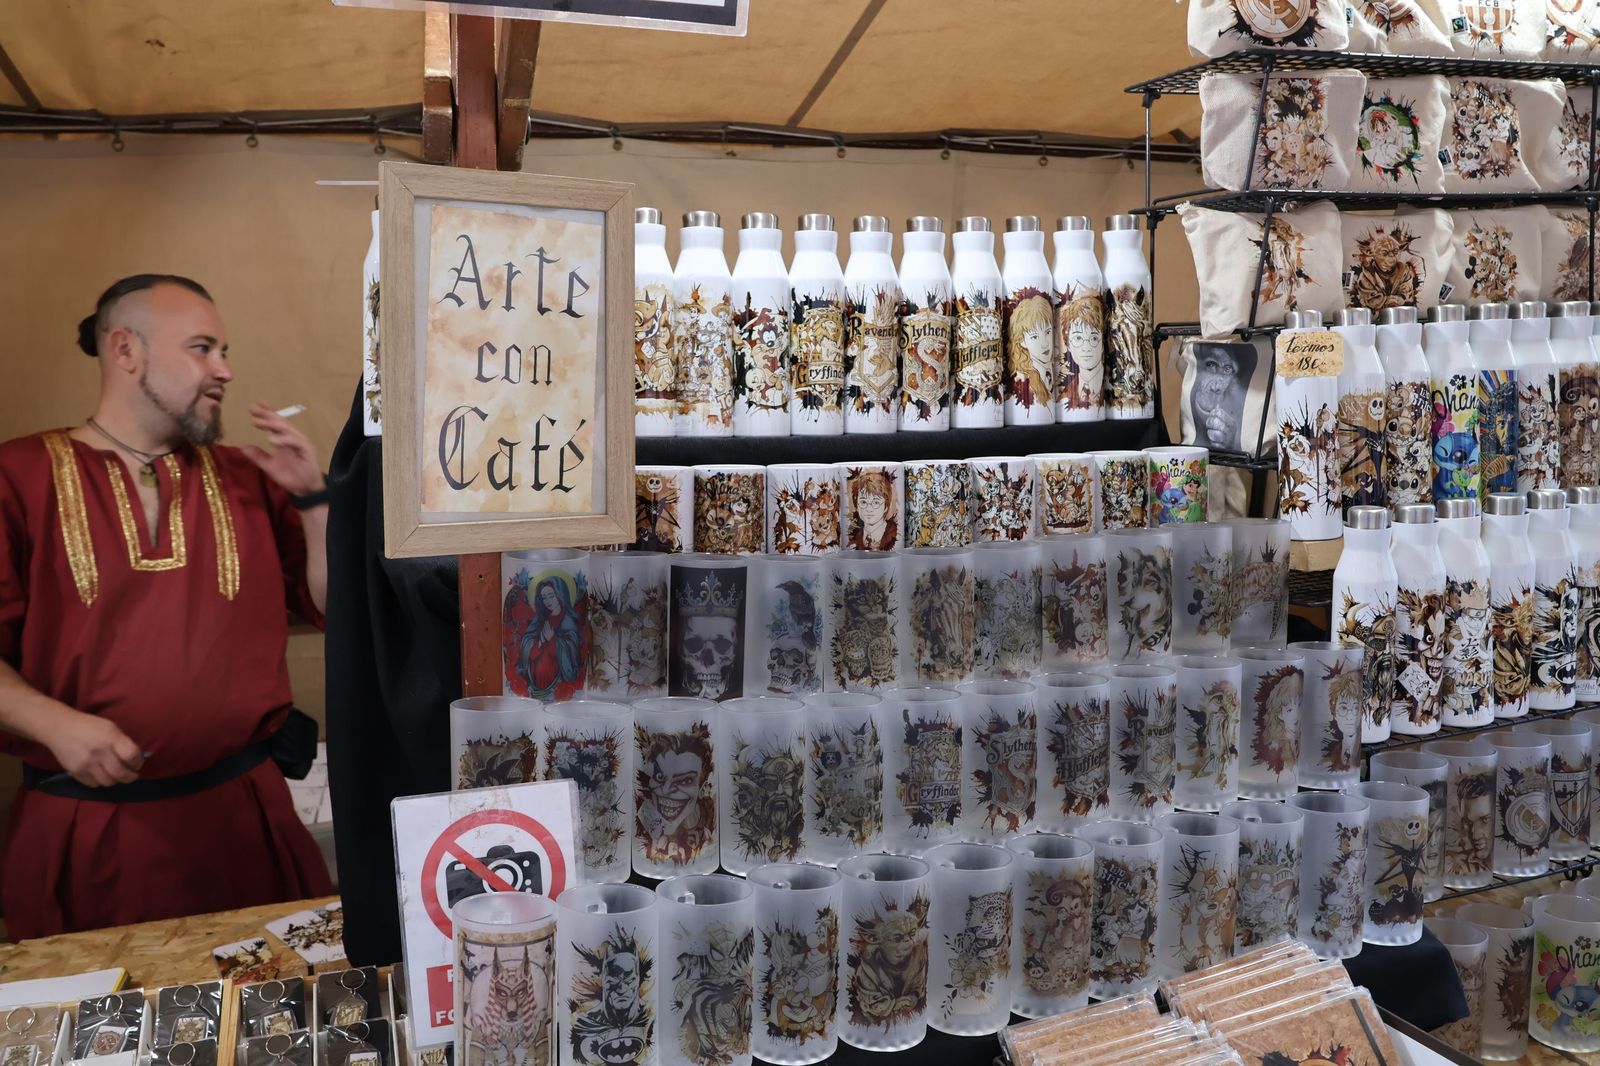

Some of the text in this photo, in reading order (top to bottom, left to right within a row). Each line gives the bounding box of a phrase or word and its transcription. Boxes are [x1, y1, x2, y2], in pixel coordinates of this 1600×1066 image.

[437, 234, 591, 319] Arte
[474, 339, 552, 387] con
[438, 405, 587, 493] Café
